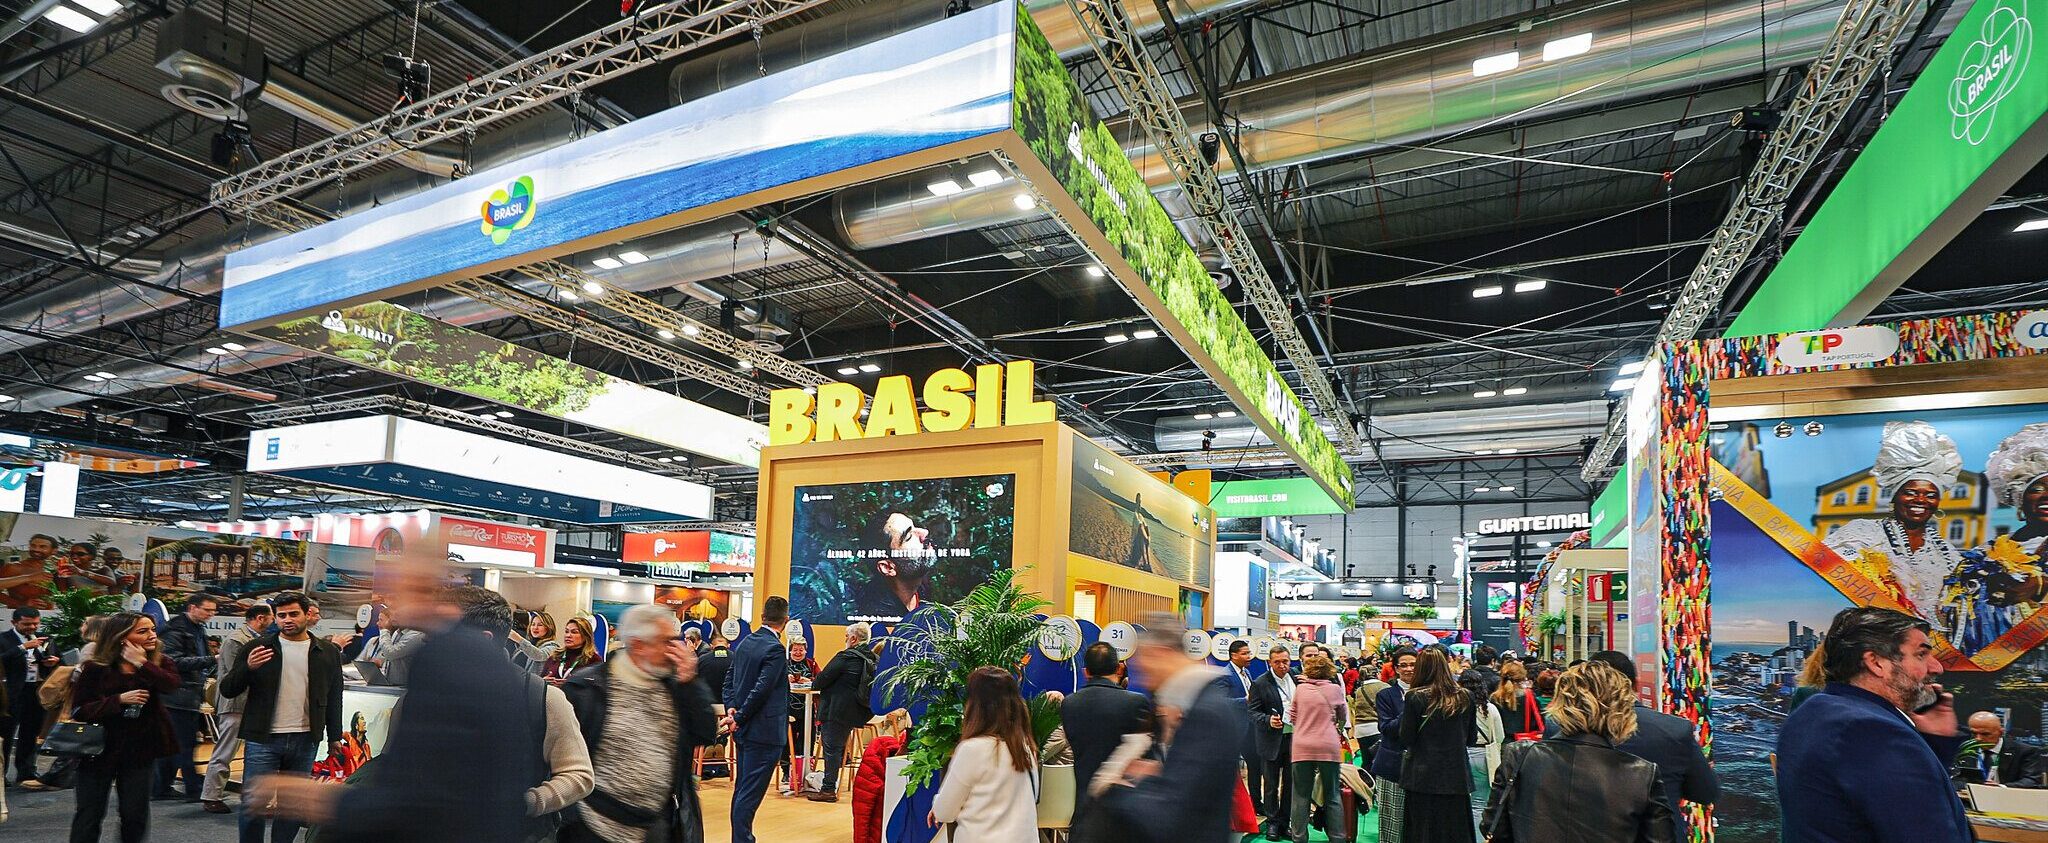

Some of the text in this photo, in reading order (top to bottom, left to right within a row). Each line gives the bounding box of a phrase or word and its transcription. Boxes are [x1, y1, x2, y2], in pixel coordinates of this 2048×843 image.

[1968, 44, 2013, 105] BRASIL
[494, 202, 524, 221] BRASIL
[354, 324, 394, 345] PARATY
[1800, 333, 1843, 354] TAP
[1837, 352, 1875, 360] PORTUGAL
[769, 359, 1056, 447] BRASIL
[1266, 369, 1302, 444] BRASIL
[1765, 516, 1812, 553] BAHIA
[1829, 565, 1877, 606] BAHIA
[1112, 629, 1124, 640] 31
[1190, 635, 1202, 644] 29
